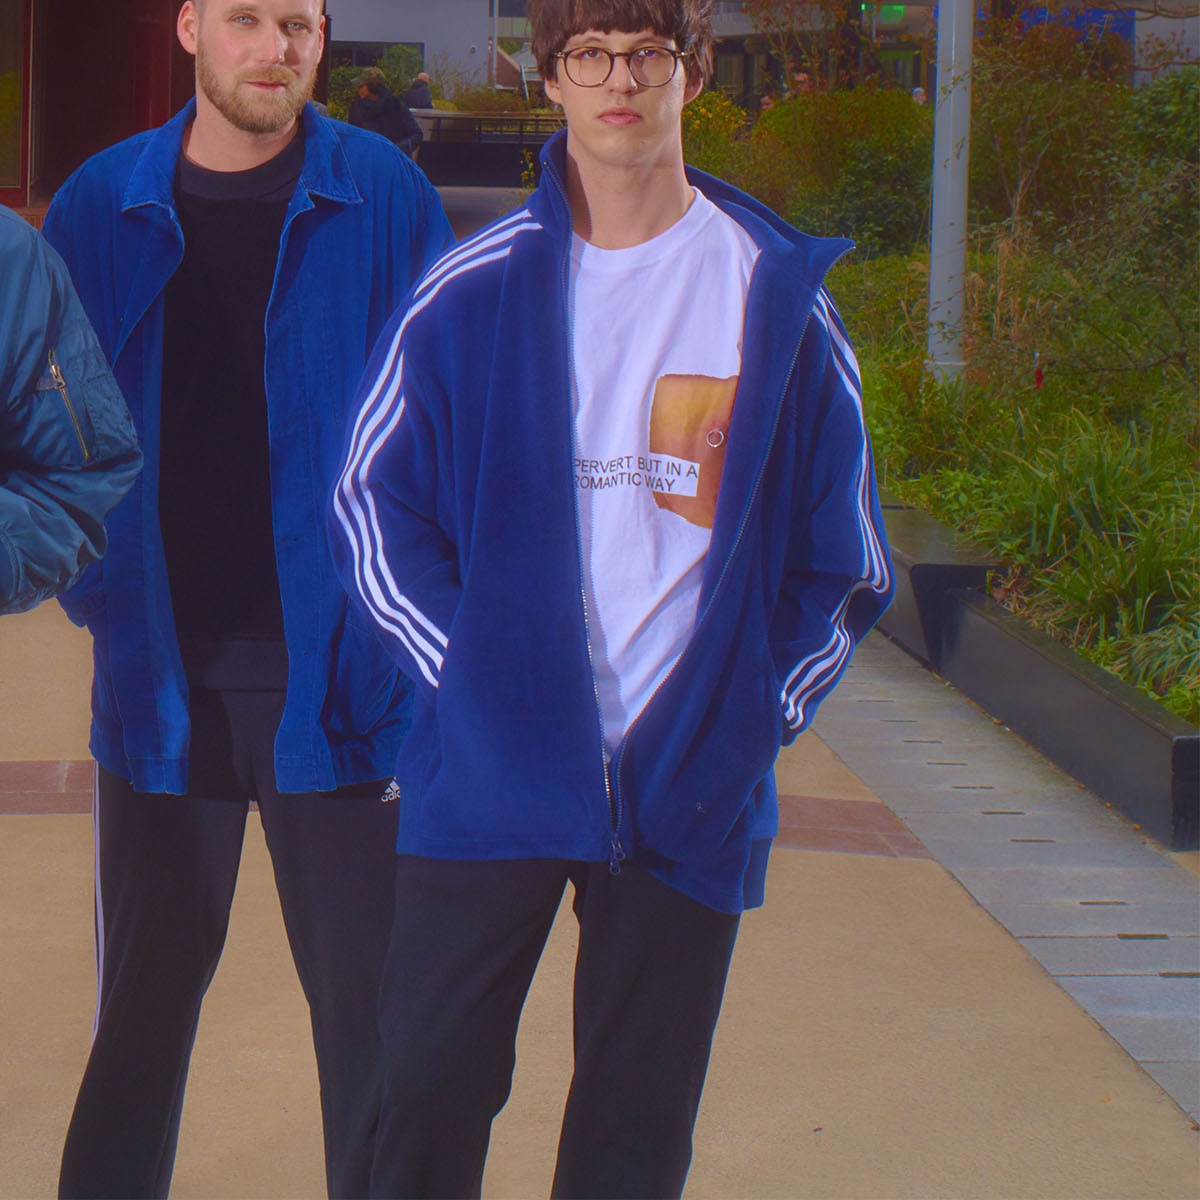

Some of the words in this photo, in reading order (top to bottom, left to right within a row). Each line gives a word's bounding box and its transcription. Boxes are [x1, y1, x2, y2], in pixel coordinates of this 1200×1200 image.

[638, 456, 662, 473] BUT
[666, 461, 681, 476] IN
[686, 464, 698, 478] A
[644, 474, 676, 492] WAY
